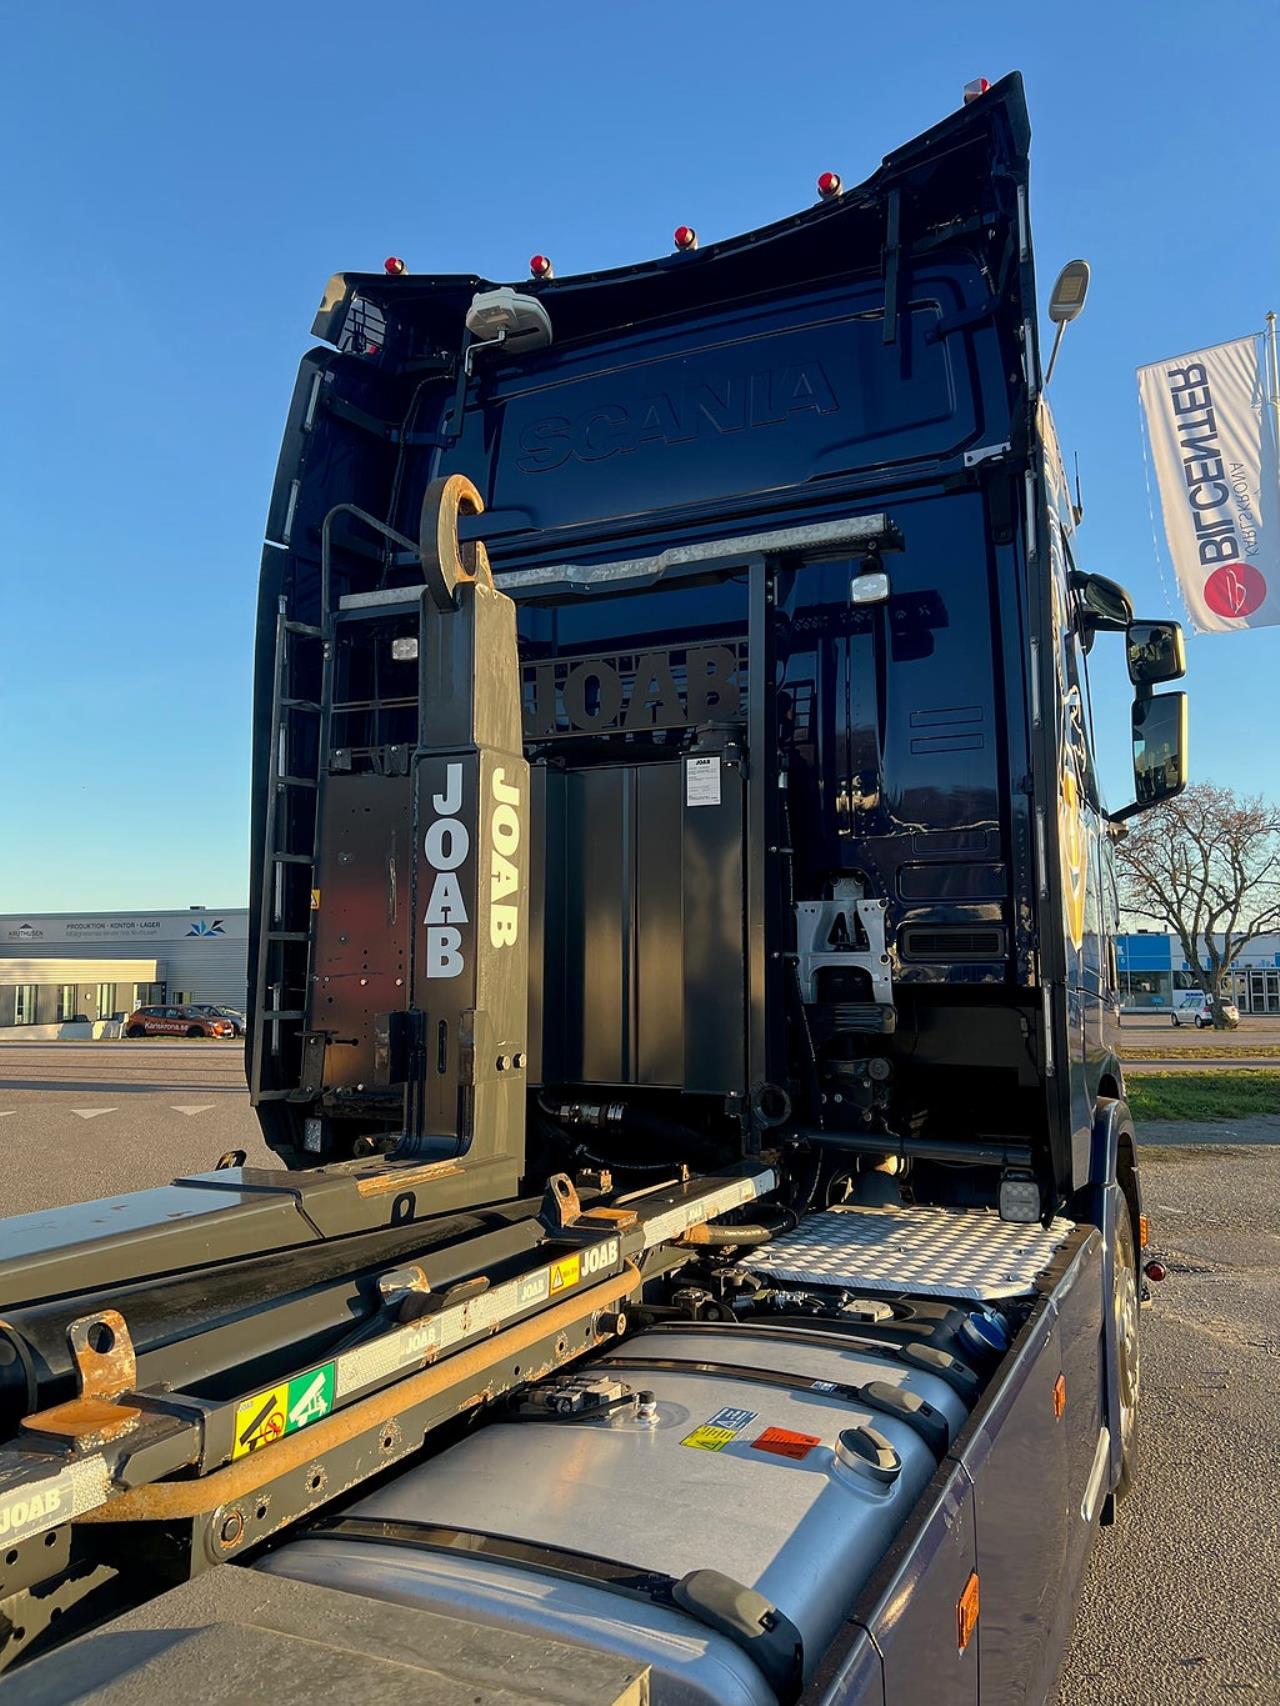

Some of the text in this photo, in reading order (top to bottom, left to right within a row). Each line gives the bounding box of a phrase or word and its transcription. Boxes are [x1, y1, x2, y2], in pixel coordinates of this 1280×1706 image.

[516, 360, 840, 473] SCANIA
[424, 763, 470, 978] JOAB
[490, 767, 520, 949] JOAB
[581, 1240, 618, 1277] JOAB
[522, 1279, 545, 1301] JOAB
[405, 1327, 436, 1354] JOAB
[0, 1487, 61, 1534] JOAB
